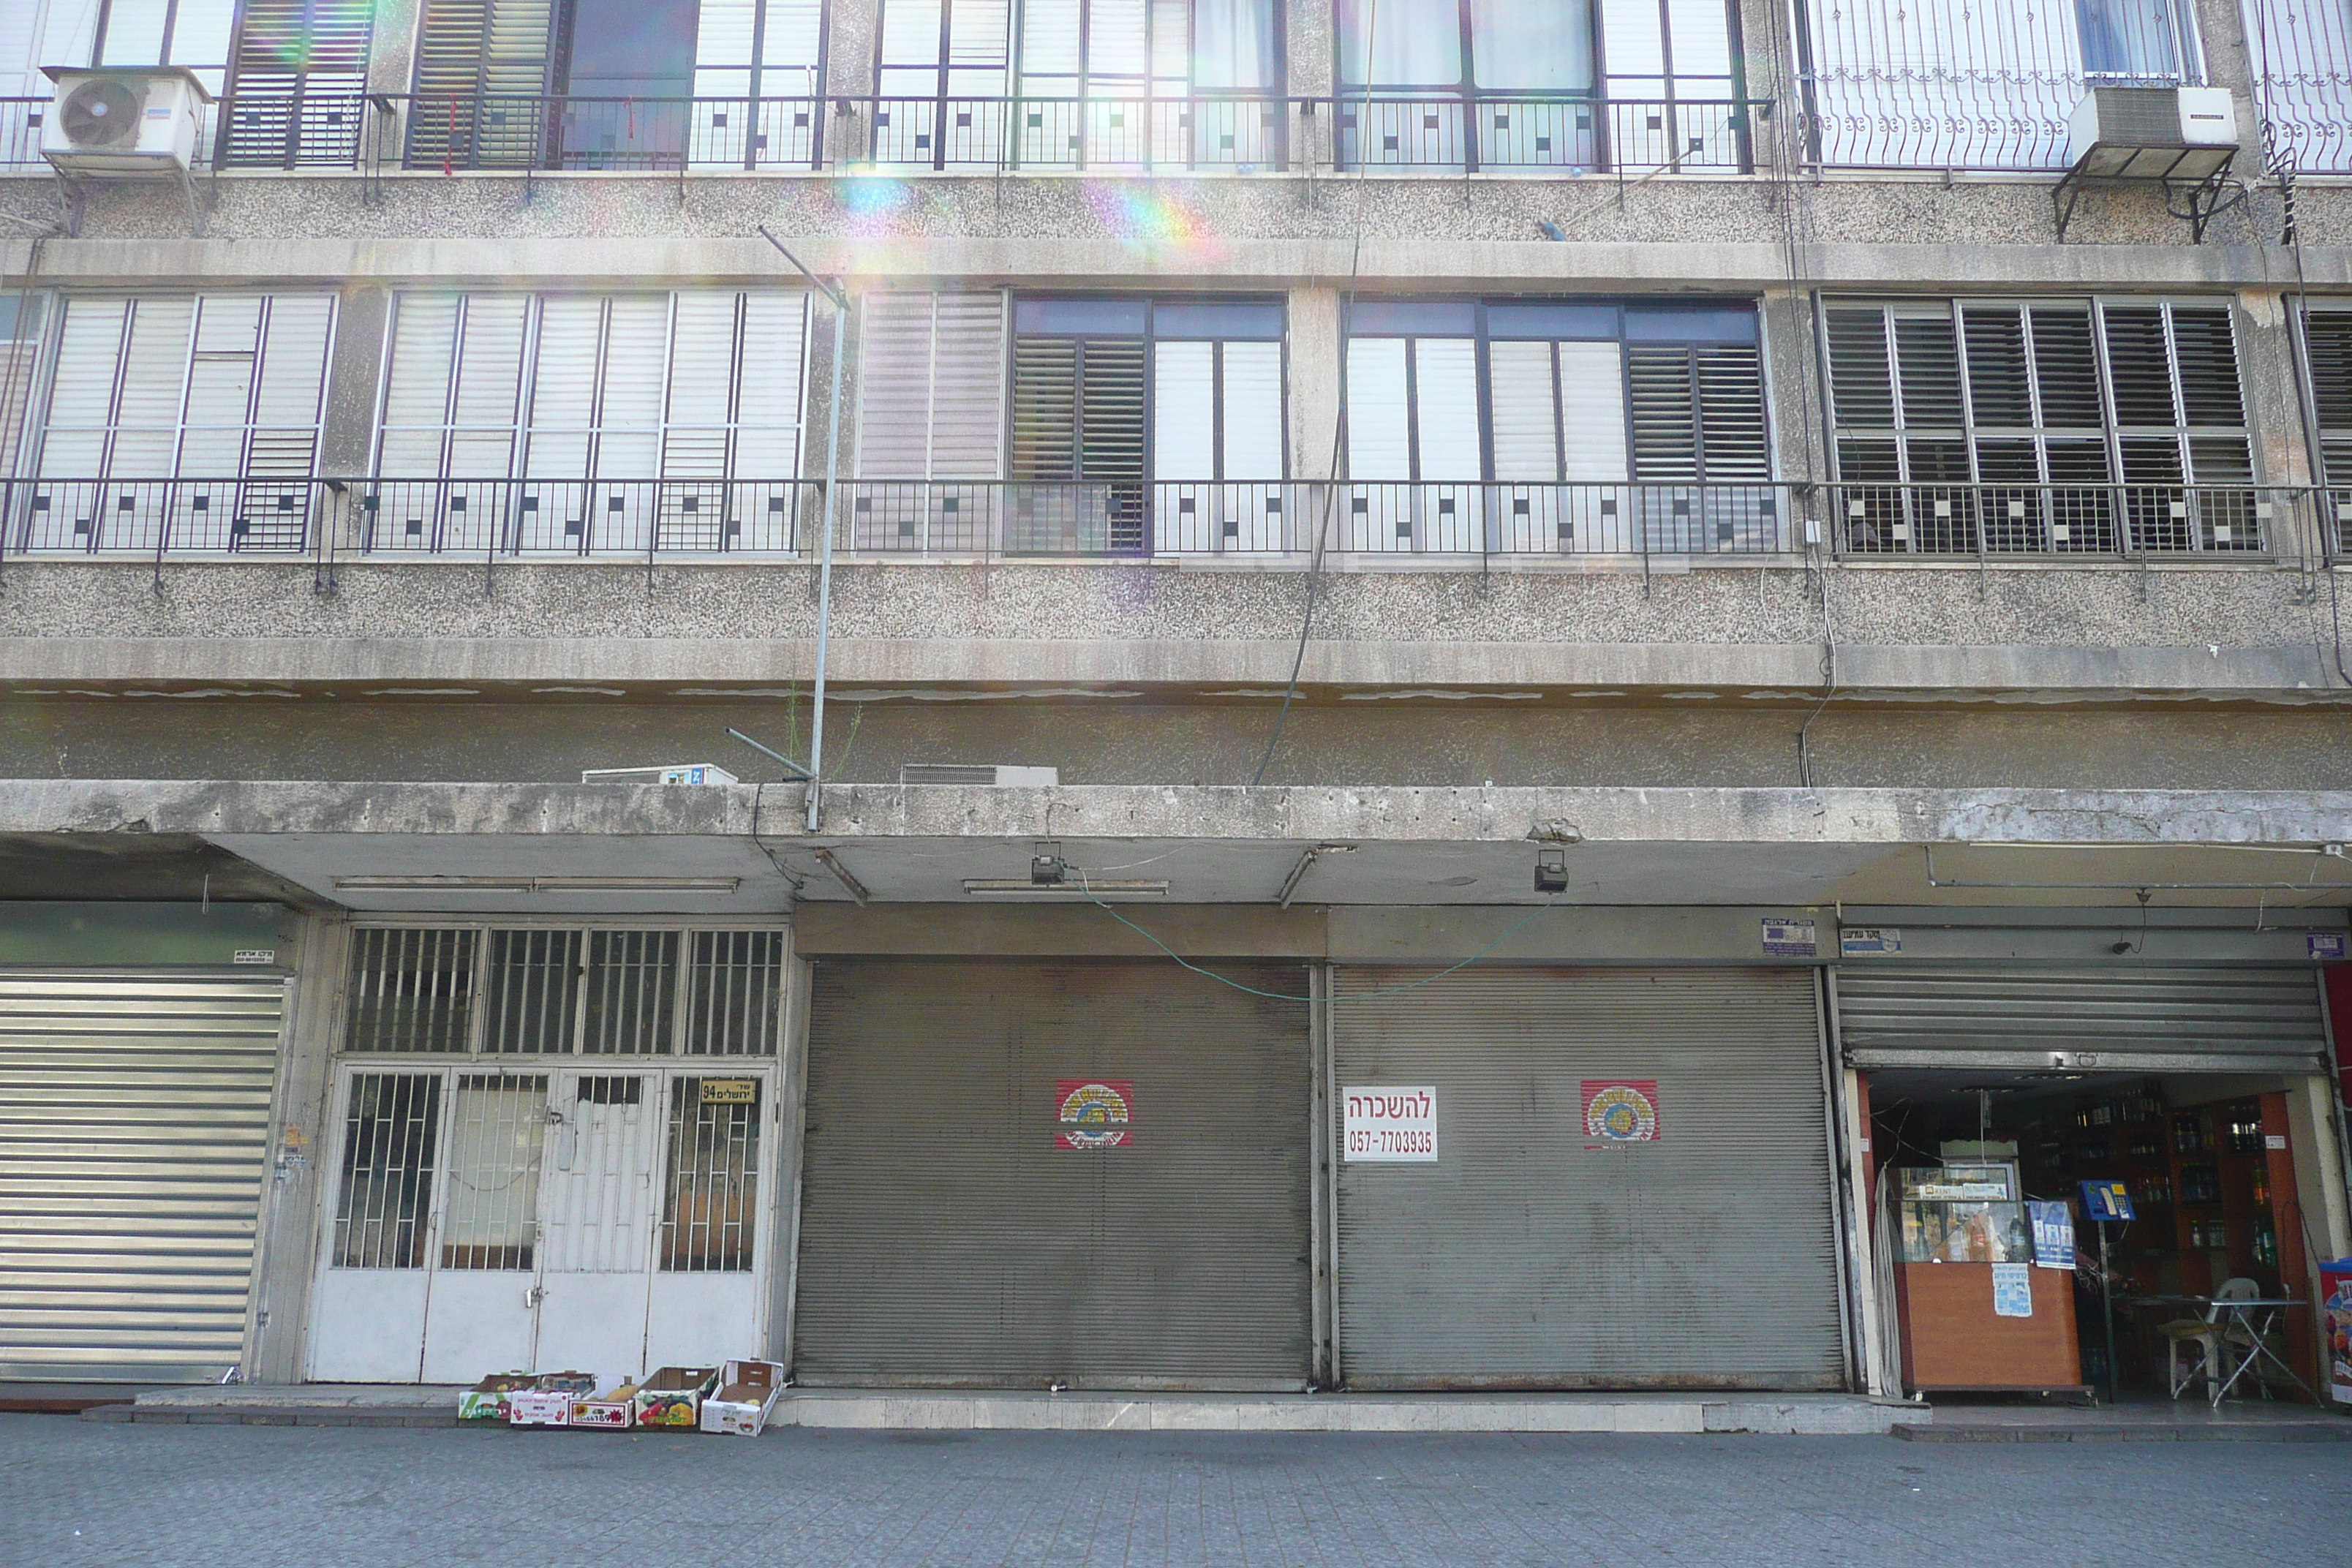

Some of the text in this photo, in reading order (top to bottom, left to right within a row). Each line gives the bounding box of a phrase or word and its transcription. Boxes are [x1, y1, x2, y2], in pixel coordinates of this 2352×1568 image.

[703, 1085, 750, 1098] ירושלים 94
[1349, 1090, 1431, 1119] להשכרה
[1349, 1131, 1432, 1153] 057-7703935
